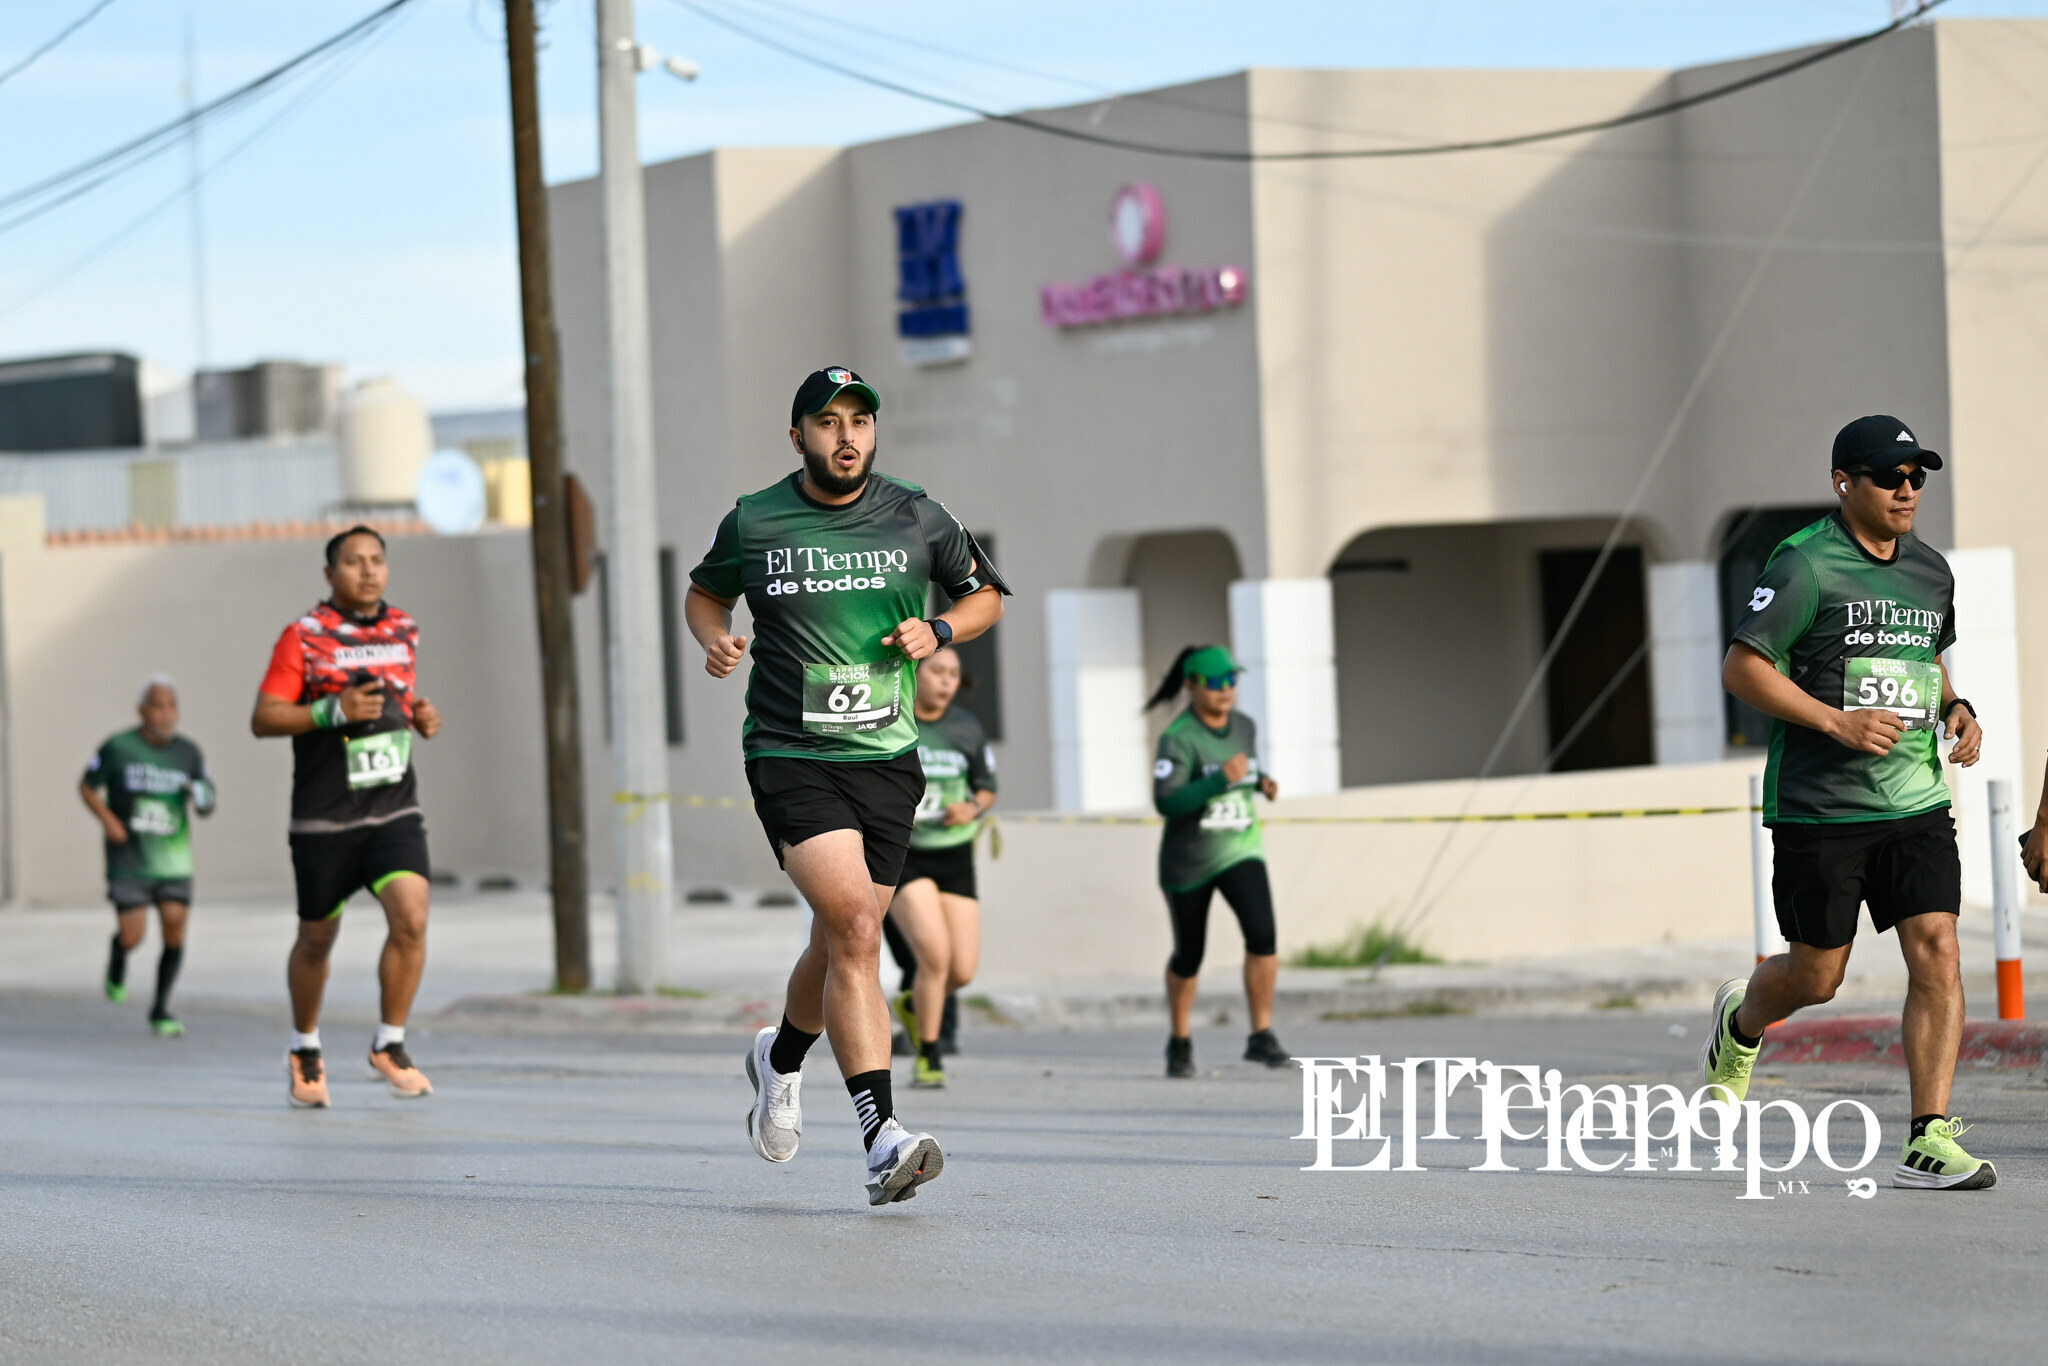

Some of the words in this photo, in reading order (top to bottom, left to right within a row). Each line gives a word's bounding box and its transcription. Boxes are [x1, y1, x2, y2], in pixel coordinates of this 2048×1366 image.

[765, 548, 794, 575] El
[798, 547, 908, 574] Tiempo
[767, 579, 799, 596] de
[803, 575, 886, 593] todos
[1845, 600, 1873, 628] El
[1876, 600, 1943, 634] Tiempo
[1844, 630, 1875, 645] de
[1877, 630, 1932, 648] todos
[828, 683, 872, 712] 62
[892, 671, 900, 716] MEDALLA
[1858, 678, 1918, 707] 596
[1928, 678, 1939, 723] MEDALLA
[357, 746, 401, 772] 161
